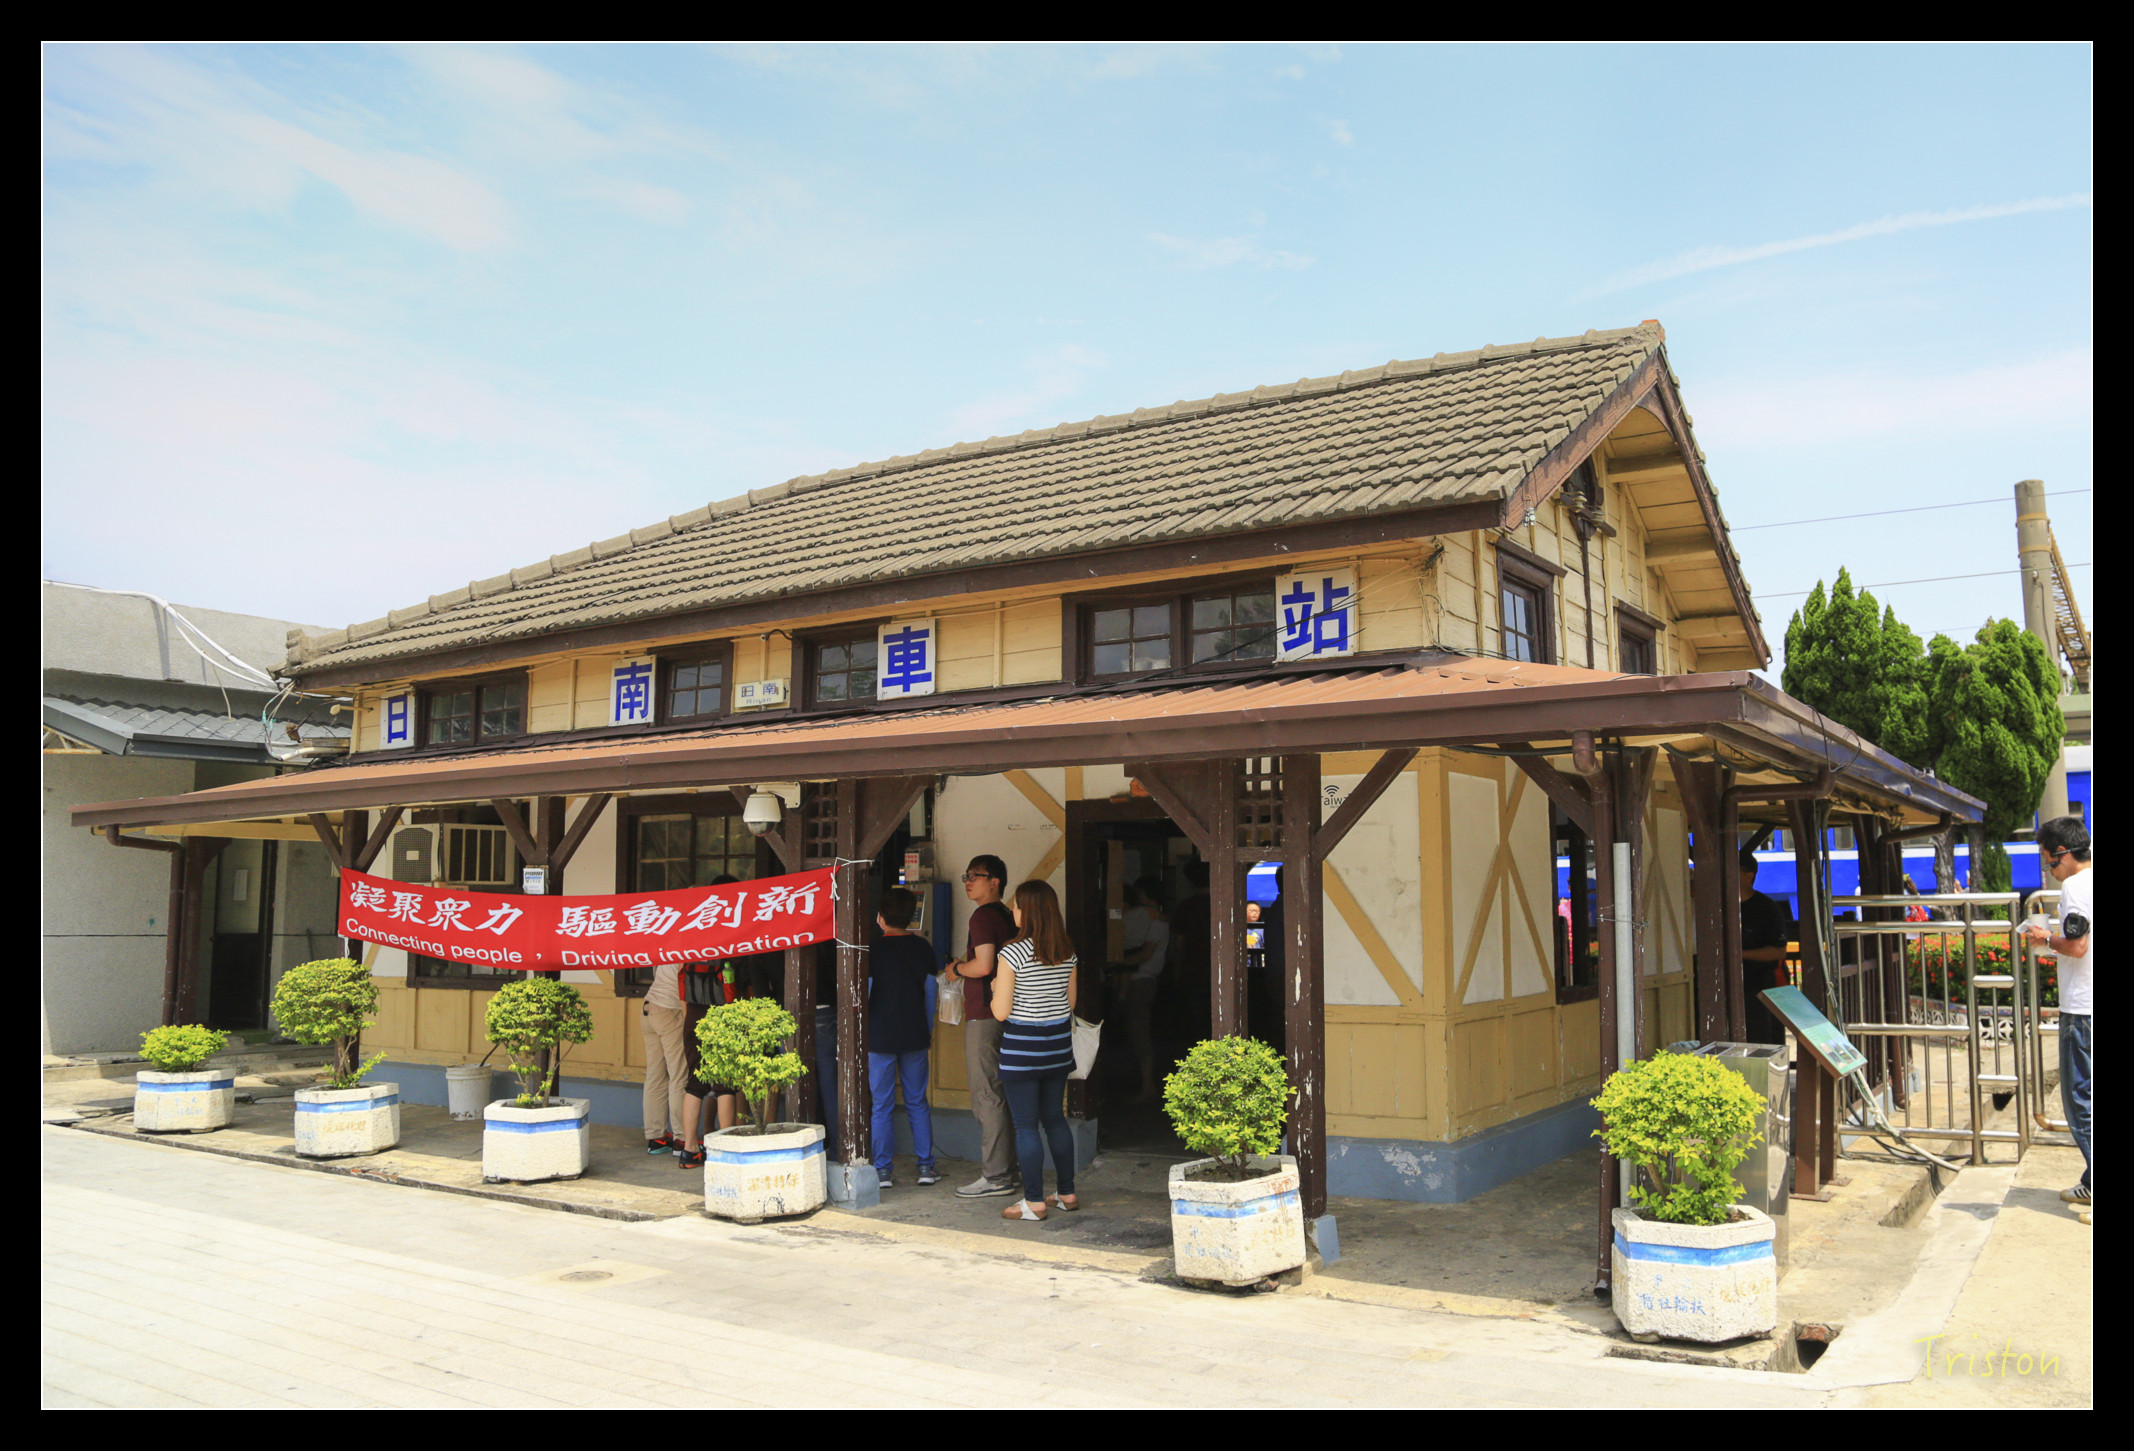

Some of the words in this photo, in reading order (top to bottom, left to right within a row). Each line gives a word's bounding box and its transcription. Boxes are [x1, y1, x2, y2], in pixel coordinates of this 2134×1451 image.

[388, 695, 408, 744] 日
[614, 661, 653, 721] 南
[882, 626, 932, 692] 車
[1281, 577, 1349, 655] 站
[555, 882, 821, 938] 驅動創新
[346, 917, 446, 957] Connecting
[561, 949, 653, 966] Driving
[658, 931, 815, 962] innovation
